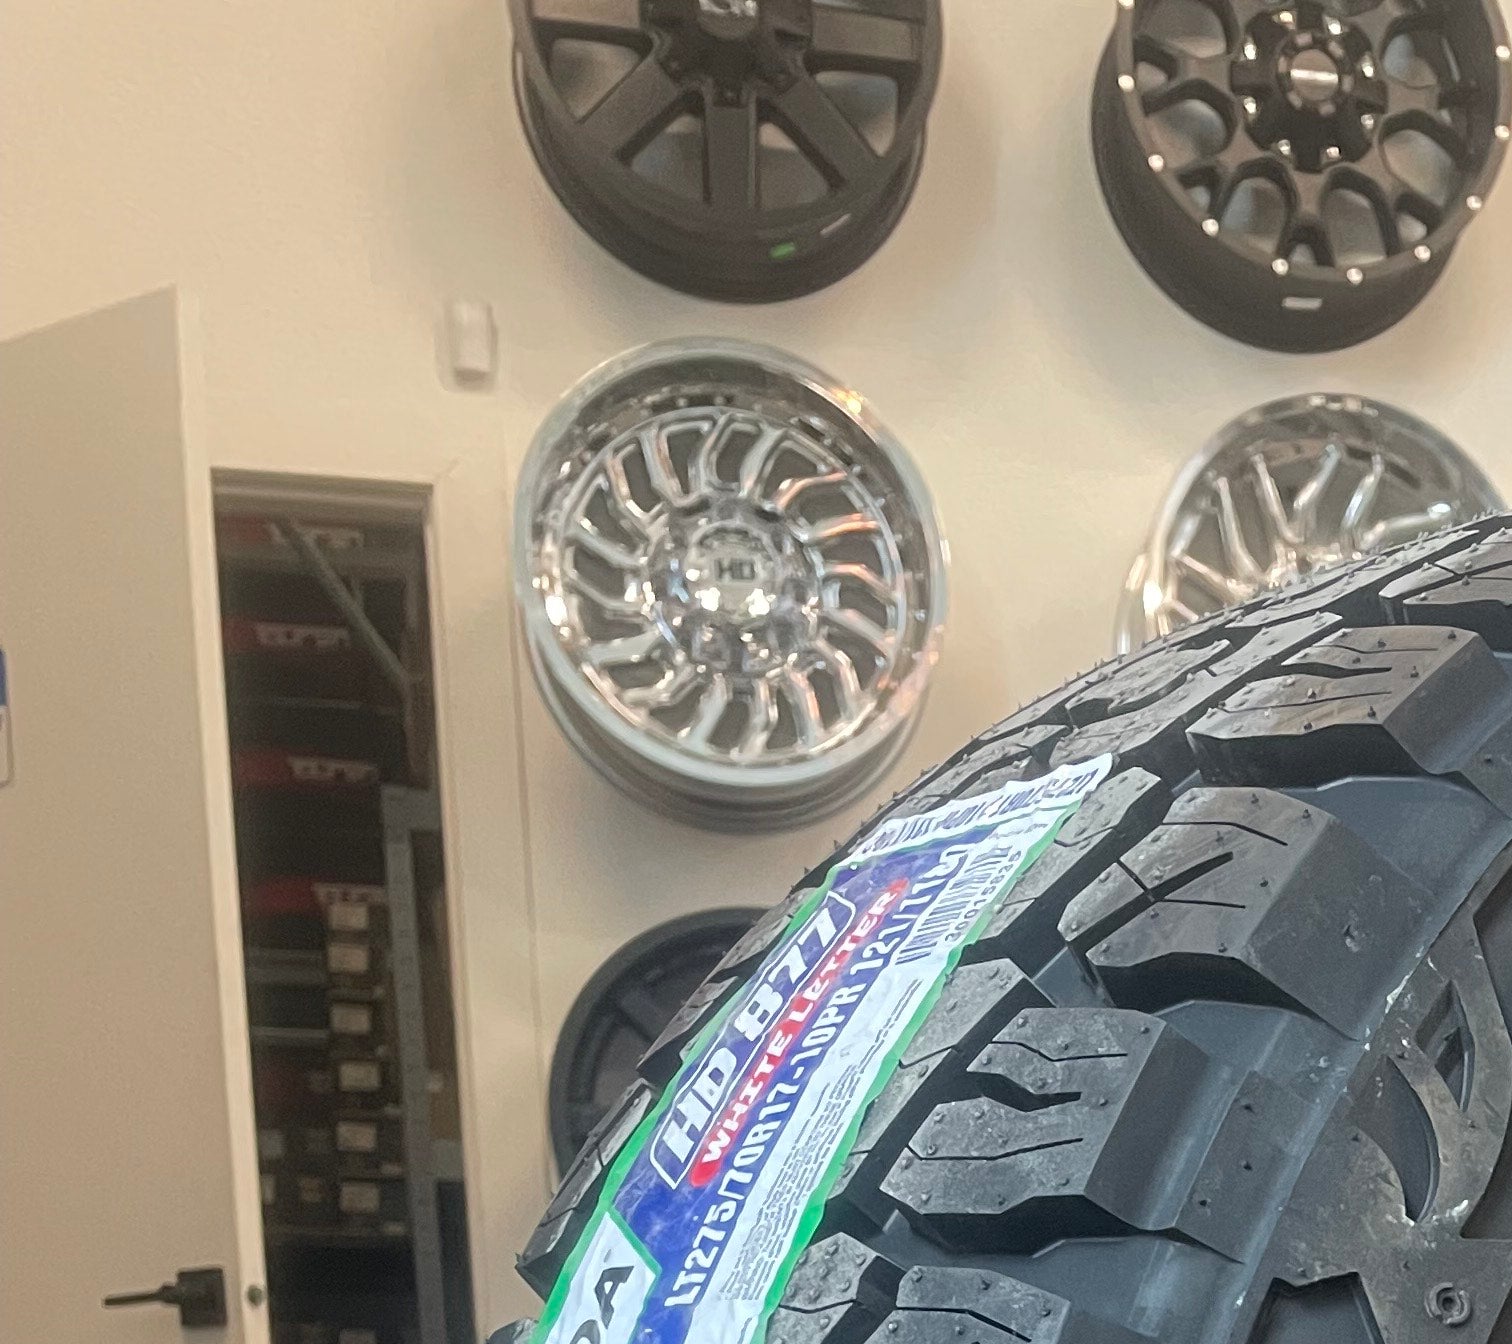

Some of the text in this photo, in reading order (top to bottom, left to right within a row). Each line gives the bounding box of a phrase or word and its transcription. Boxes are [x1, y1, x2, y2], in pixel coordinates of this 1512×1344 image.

[660, 1048, 738, 1163] HD
[735, 912, 838, 1042] 877
[702, 1030, 794, 1162] WHITE
[787, 890, 898, 1022] LETTER
